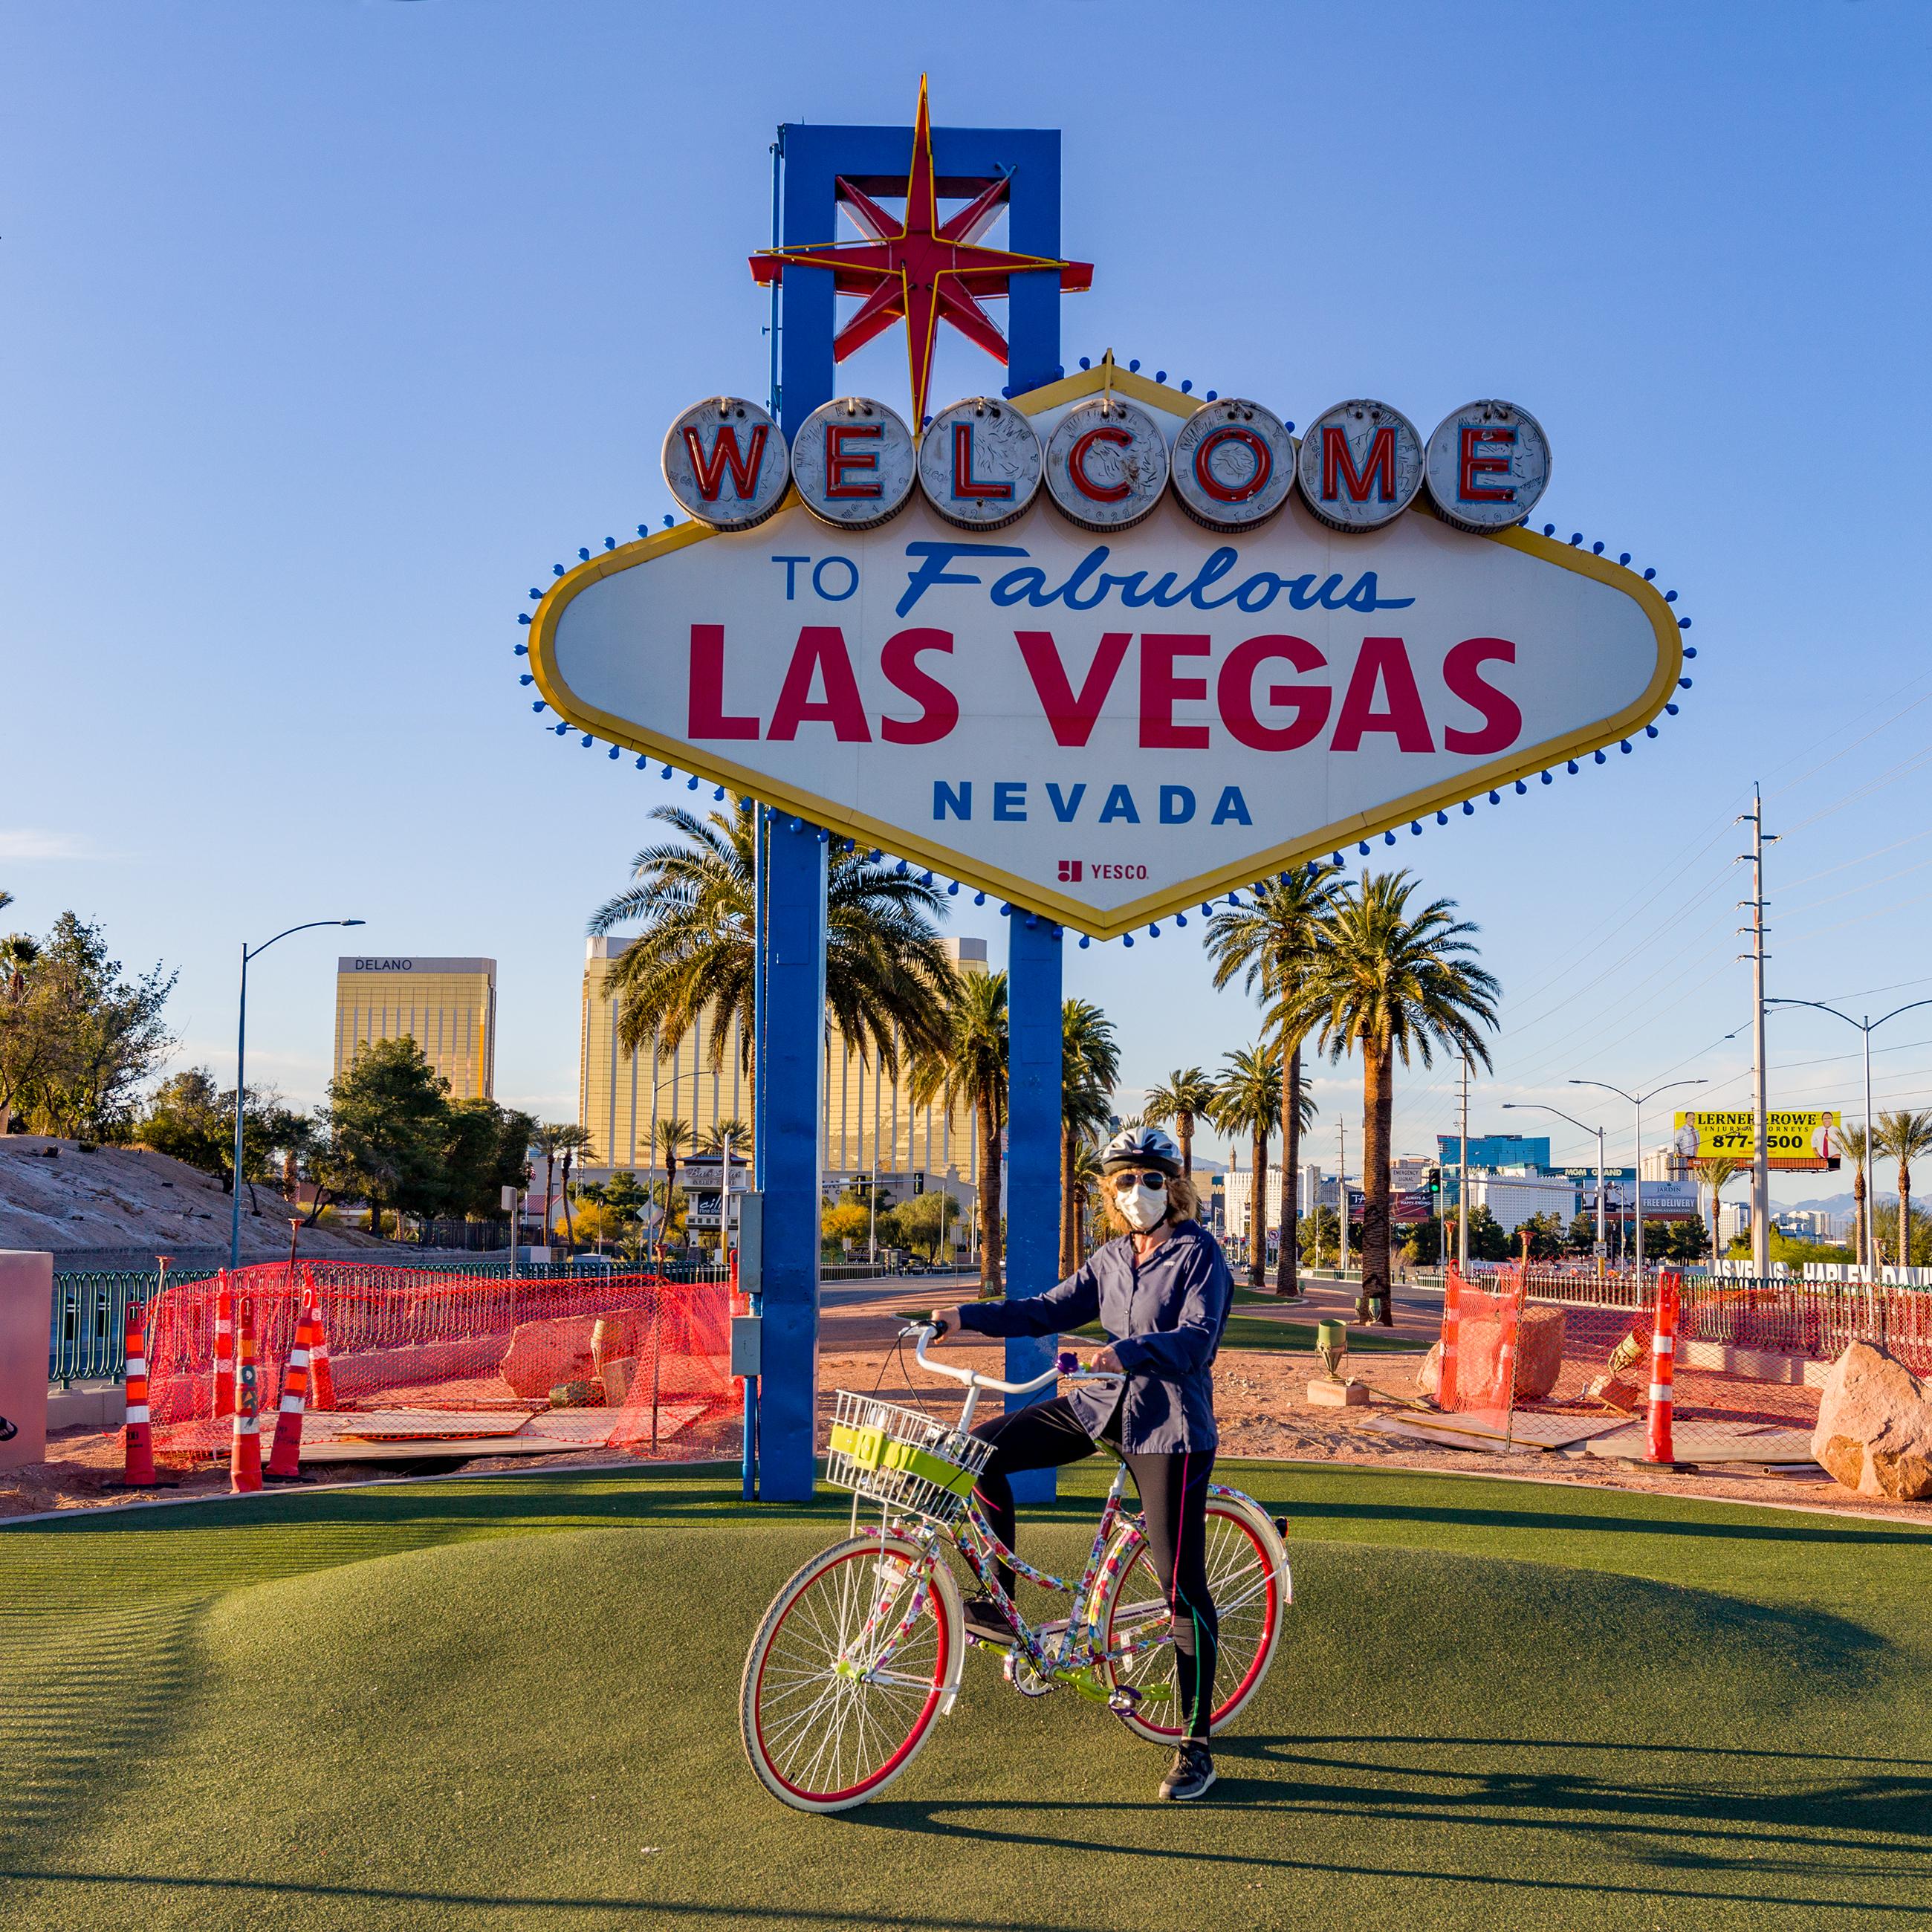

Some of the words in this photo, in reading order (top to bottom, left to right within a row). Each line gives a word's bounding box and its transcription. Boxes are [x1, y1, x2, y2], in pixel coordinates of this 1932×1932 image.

[681, 421, 1519, 505] WELCOME
[772, 557, 858, 601] TO
[896, 543, 1415, 619] Fabulous
[689, 625, 959, 744] LAS
[1015, 632, 1522, 754] VEGAS
[933, 780, 1253, 826] NEVADA
[355, 959, 412, 970] DELANO
[1712, 1135, 1803, 1148] 877-500
[1564, 1168, 1587, 1176] MGM
[1591, 1168, 1623, 1176] GAND
[1642, 1198, 1661, 1208] FREE
[1661, 1198, 1695, 1208] DELIVERY
